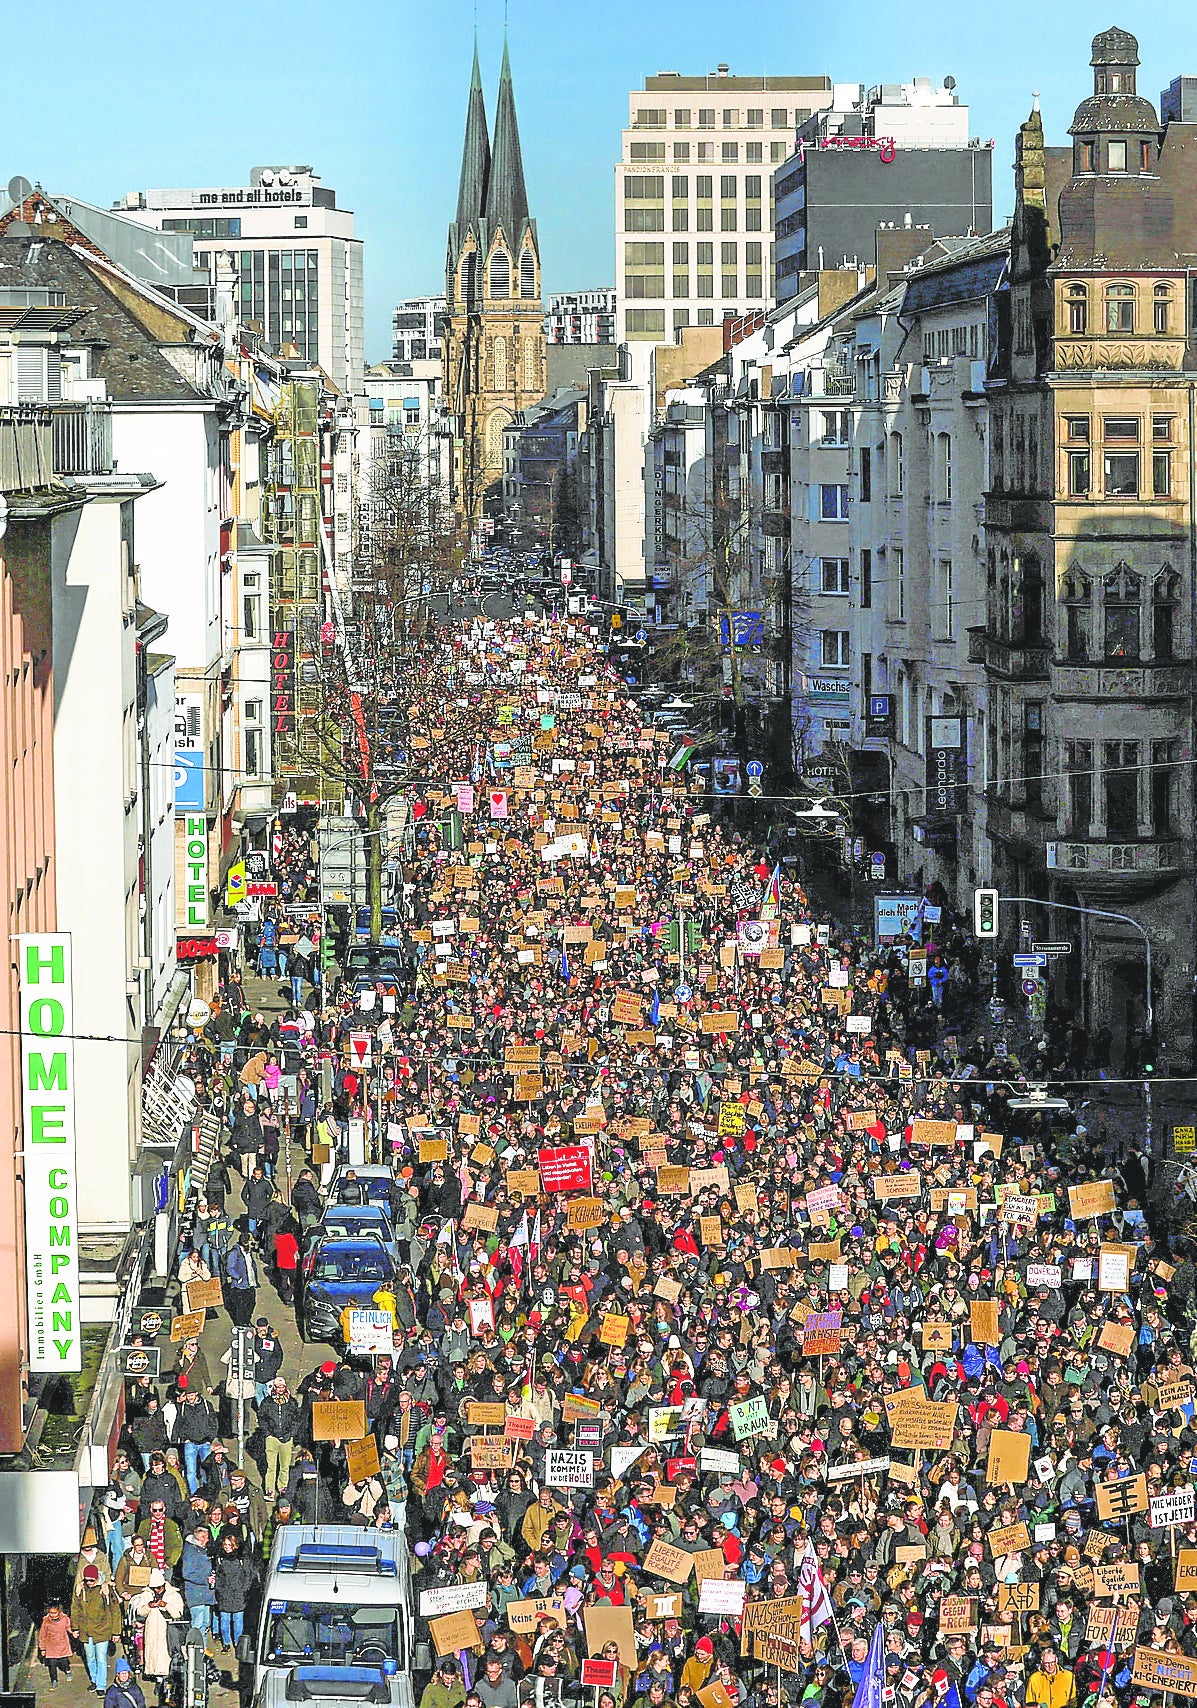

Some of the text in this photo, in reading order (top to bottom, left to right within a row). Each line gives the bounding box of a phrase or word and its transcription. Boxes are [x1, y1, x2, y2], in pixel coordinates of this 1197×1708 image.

[651, 166, 680, 174] FRANCIS
[200, 188, 303, 203] me and all hotels
[273, 632, 289, 732] HOTEL
[807, 766, 841, 776] HOTEL
[936, 750, 947, 810] Leonardo
[188, 818, 205, 925] HOTEL
[26, 945, 68, 1145] HOME
[48, 1167, 74, 1360] COMPANY
[34, 1253, 46, 1360] Immobilien GmbH
[352, 1311, 392, 1324] PEINLICH
[1160, 1384, 1189, 1396] KEIN ALT
[1172, 1392, 1190, 1403] NAZIS
[508, 1421, 533, 1431] Theater
[738, 1417, 768, 1435] BRAUN
[550, 1452, 586, 1464] NAZIS
[551, 1465, 587, 1473] KOMMEN
[1152, 1496, 1192, 1510] NIE WIEDER
[1155, 1508, 1194, 1525] IST JETZT
[654, 1544, 686, 1560] LIBERTÉ
[1096, 1566, 1123, 1576] Liberté
[1179, 1565, 1197, 1578] EKE
[1004, 1583, 1036, 1596] FCK
[535, 1600, 547, 1611] ist
[1003, 1595, 1034, 1611] AFD
[512, 1614, 533, 1624] Keine
[744, 1603, 773, 1628] NAZIS
[943, 1606, 966, 1617] GEGEN
[1090, 1609, 1115, 1625] KEIN
[1115, 1627, 1136, 1642] HASS
[1139, 1652, 1191, 1671] Diese Demo
[585, 1666, 612, 1677] Theater
[1141, 1662, 1193, 1680] ist NICHT
[1133, 1671, 1197, 1692] KI-GENERIERT
